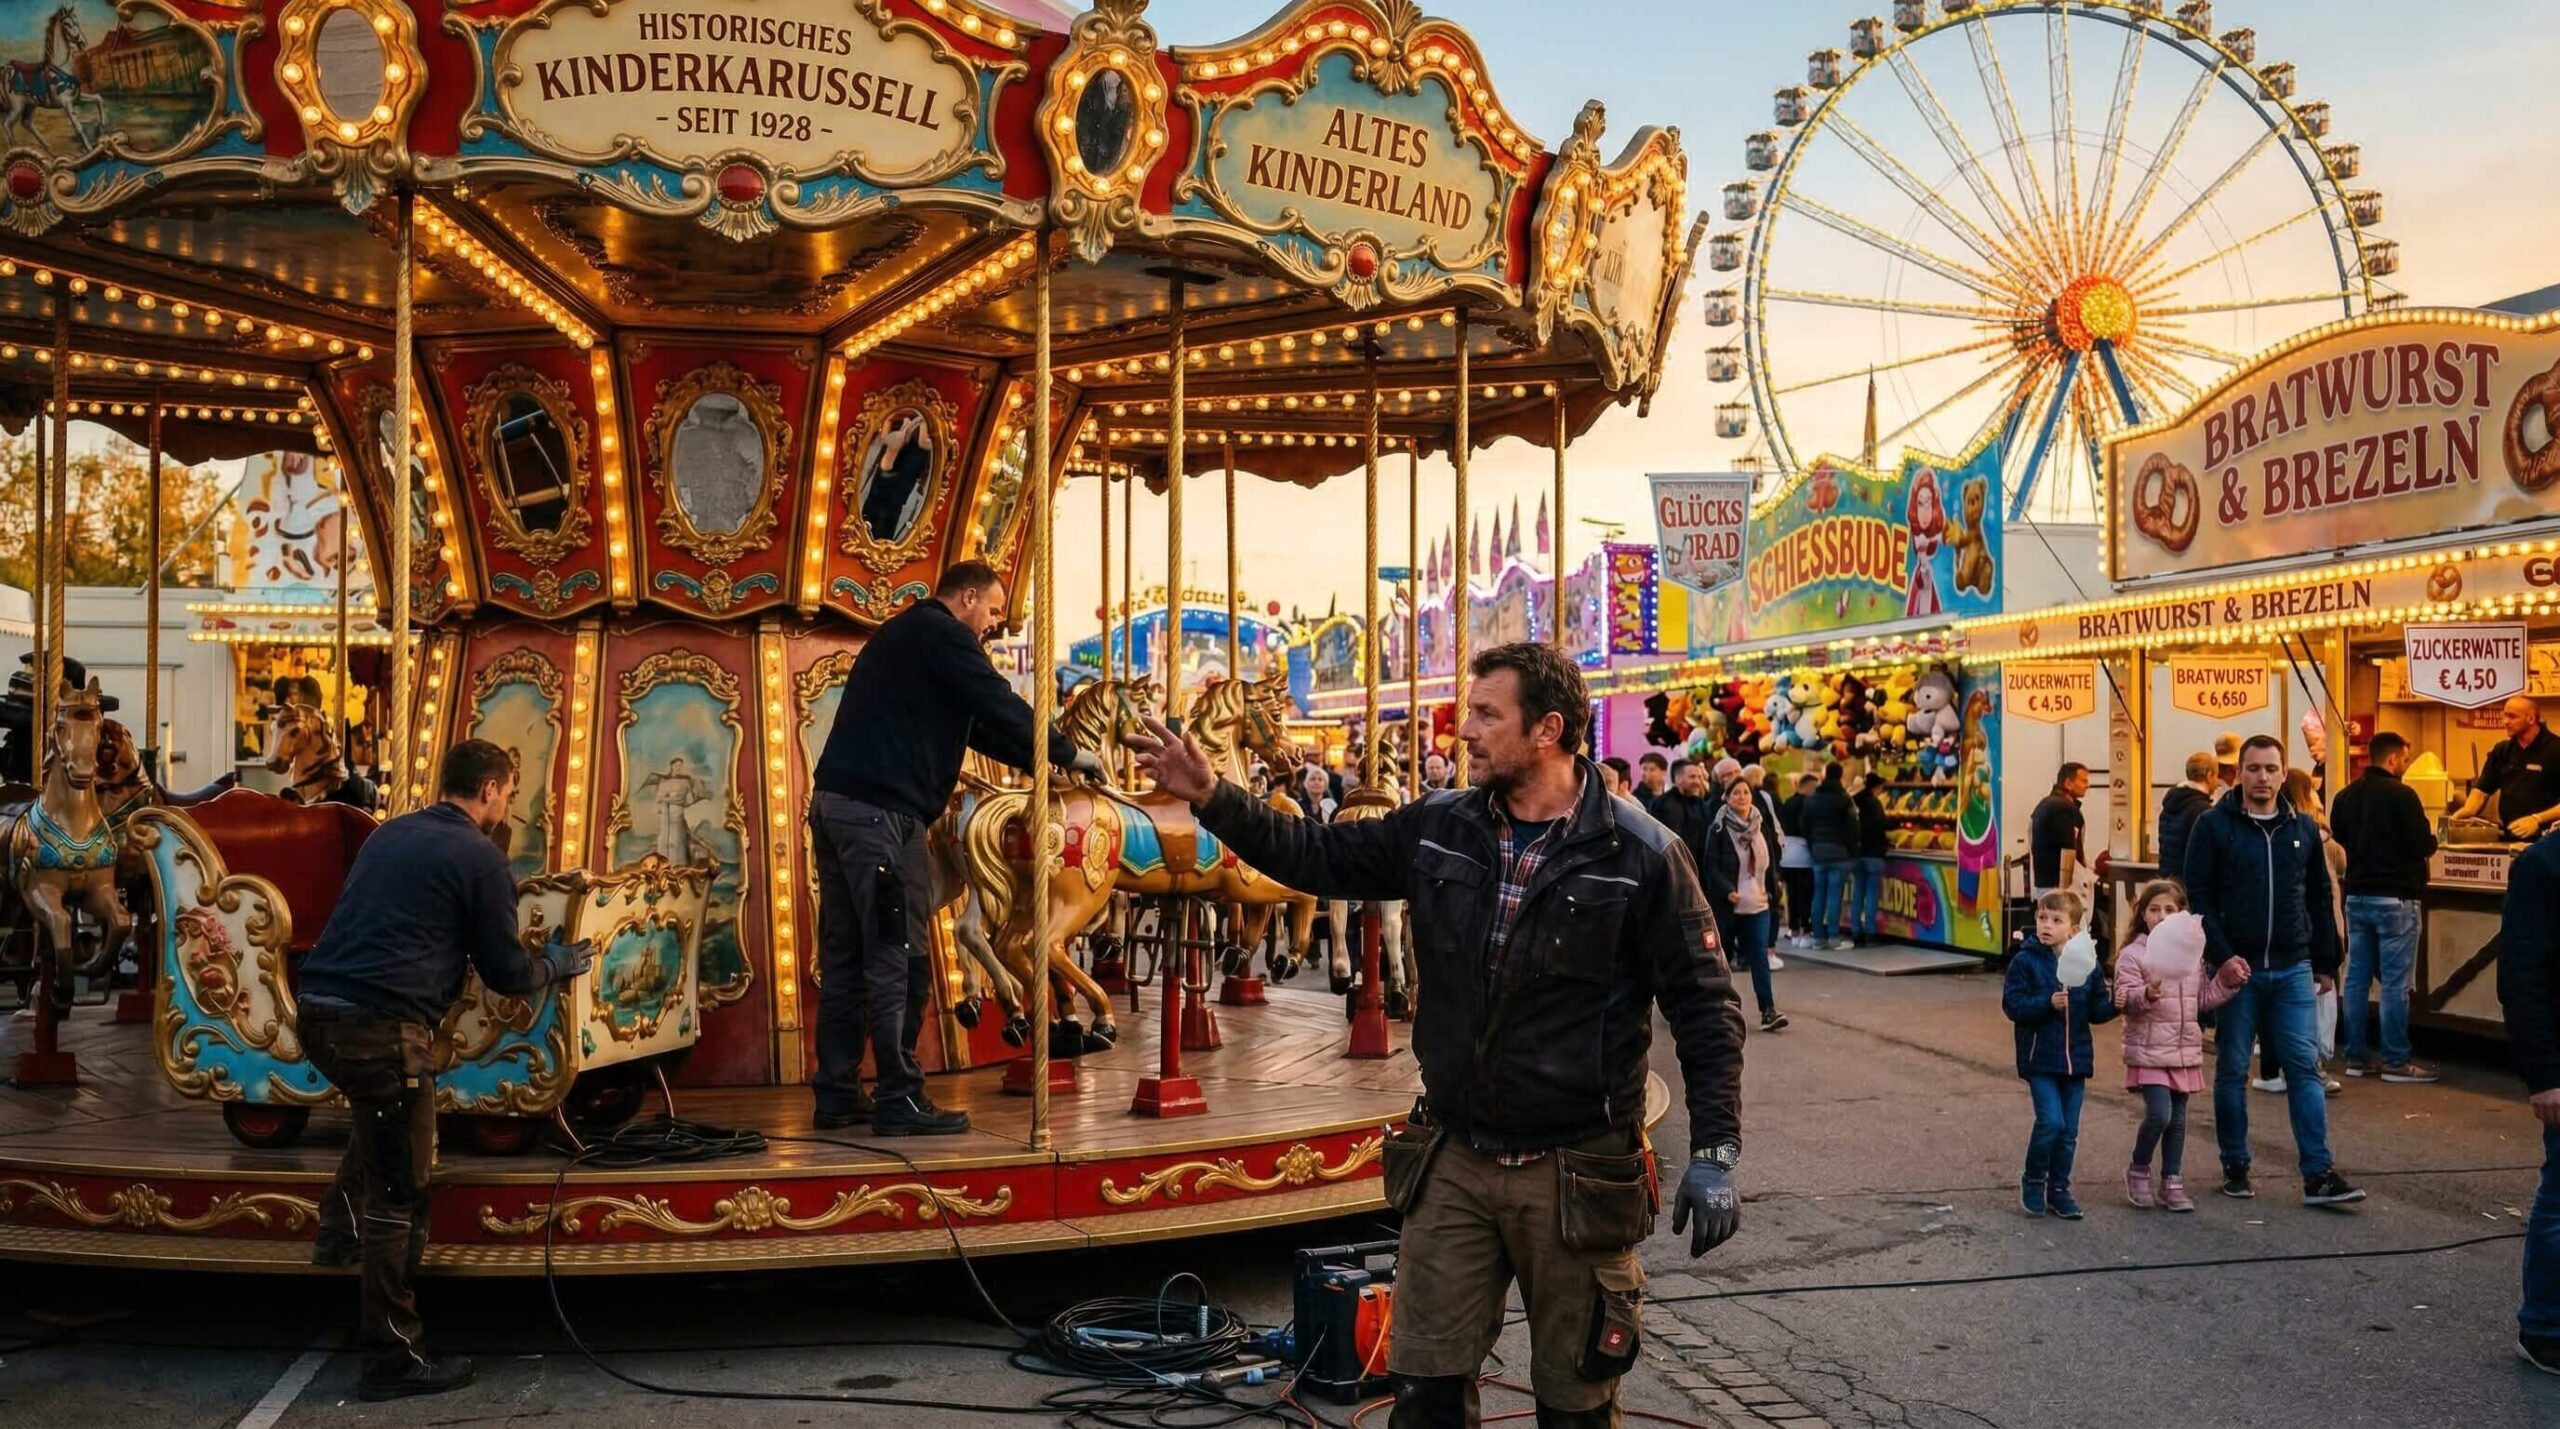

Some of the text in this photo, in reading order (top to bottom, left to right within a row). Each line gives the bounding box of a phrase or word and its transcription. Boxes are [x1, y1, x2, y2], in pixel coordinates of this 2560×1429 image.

[639, 13, 852, 55] HISTORISCHES
[535, 52, 941, 131] KINDERKARUSSELL
[677, 107, 738, 135] SEIT
[750, 111, 811, 142] 1928
[1322, 107, 1430, 169] ALTES
[1246, 143, 1473, 232] KINDERLAND
[2203, 341, 2499, 471] BRATWURST
[2218, 414, 2481, 525] & BREZELN
[1660, 494, 1743, 528] GLÜCKS
[1748, 519, 1909, 613] SCHIESSBUDE
[2079, 579, 2371, 640] BRATWURST & BREZELN
[2412, 637, 2521, 661] ZUCKERWATTE
[2008, 674, 2091, 690] ZUCKERWATTE
[2176, 668, 2264, 685] BRATWURST
[2439, 668, 2451, 690] €
[2455, 668, 2497, 693] 4,50
[2041, 695, 2073, 713] 4,50
